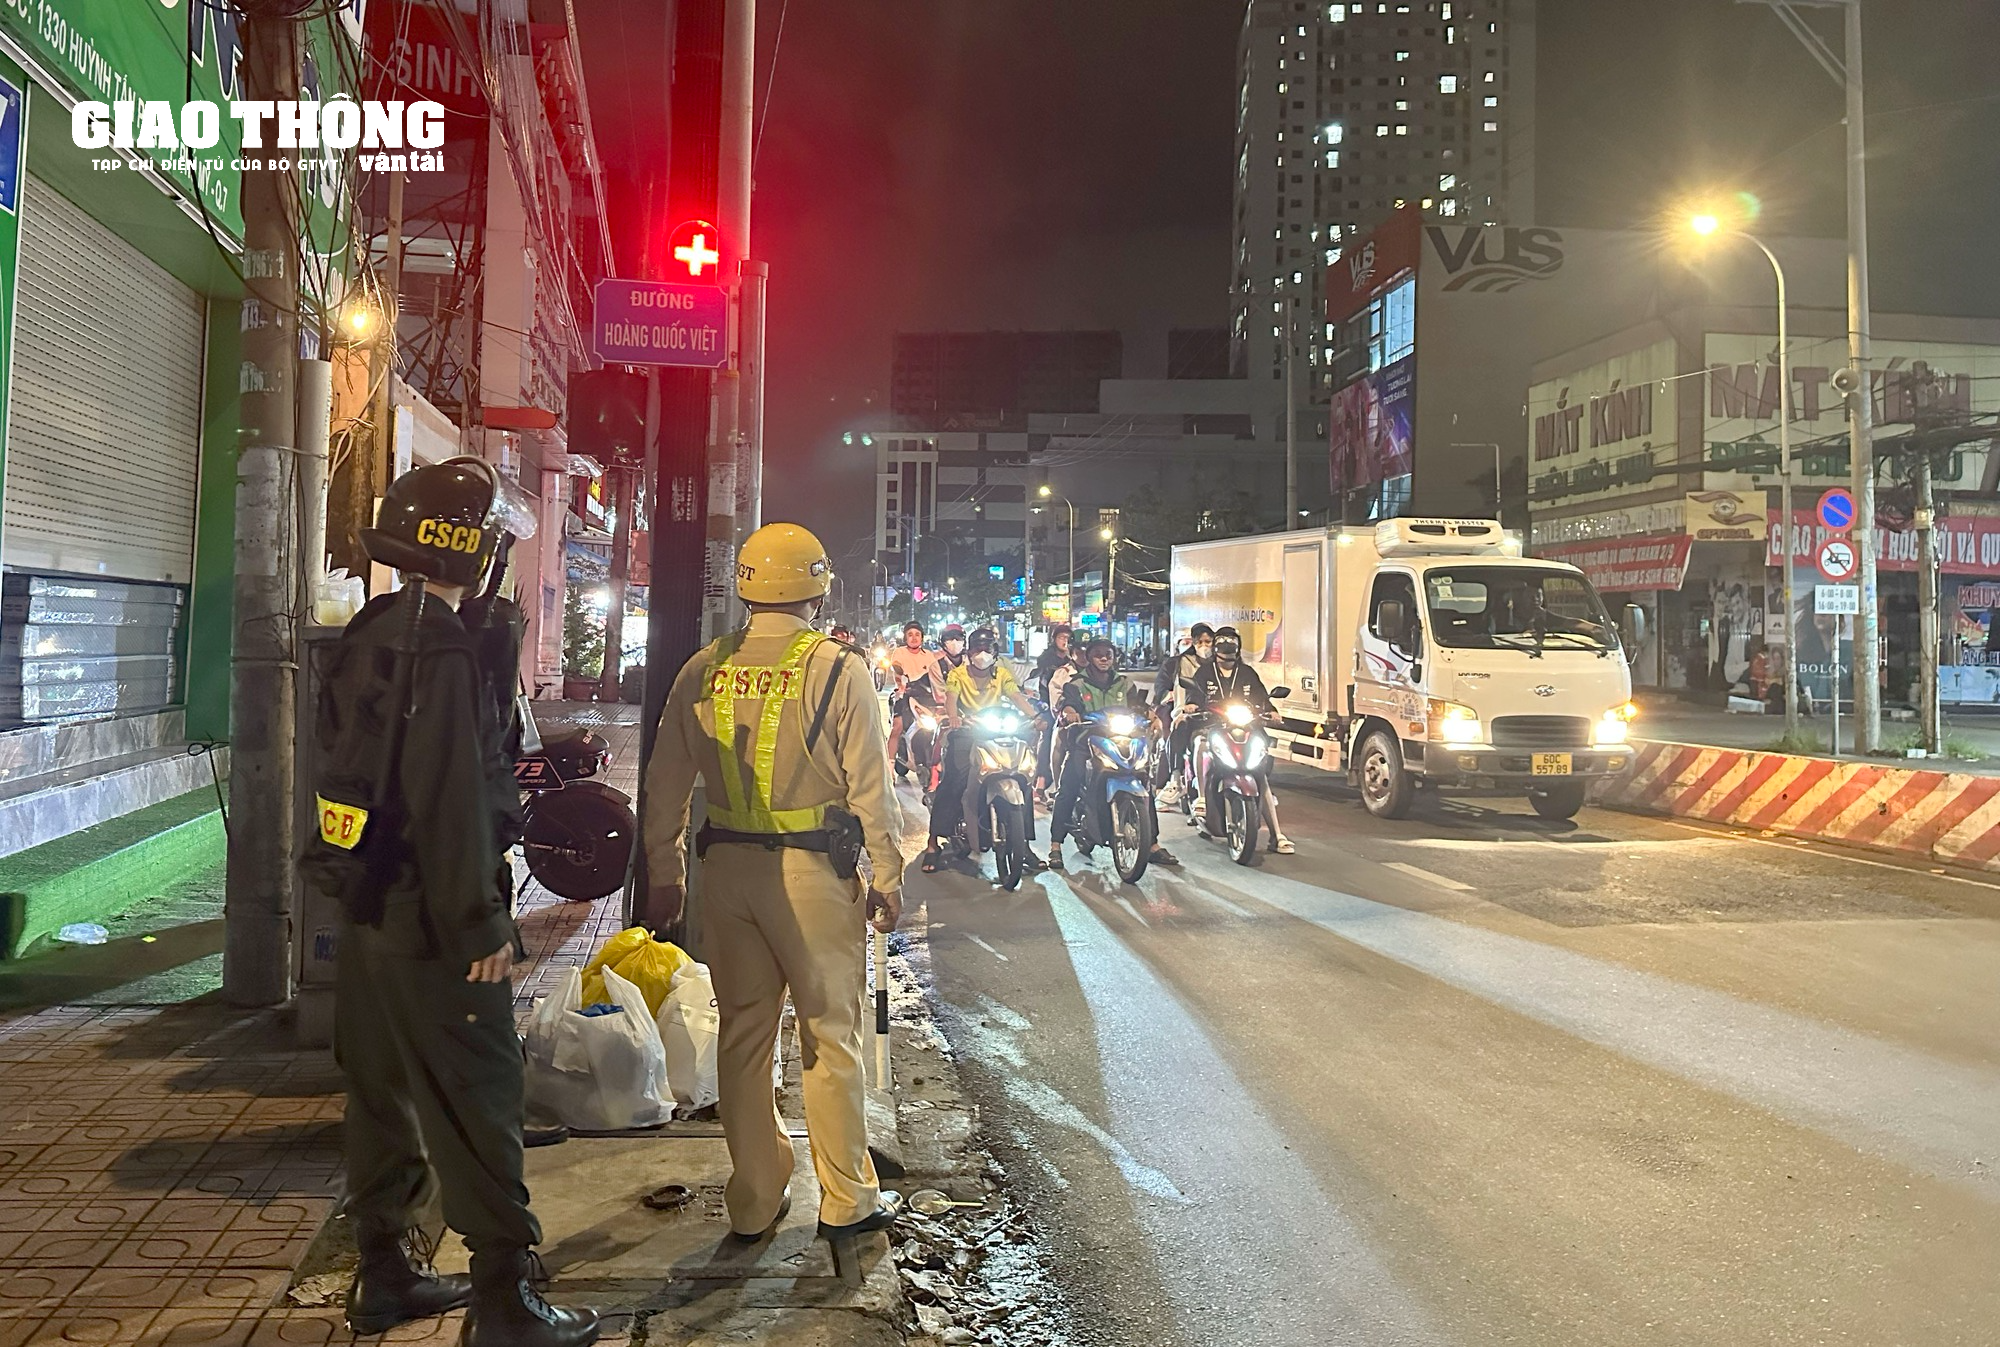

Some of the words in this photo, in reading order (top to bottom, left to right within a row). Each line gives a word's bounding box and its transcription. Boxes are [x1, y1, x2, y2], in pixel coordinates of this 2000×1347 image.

[37, 1, 67, 55] 1330
[69, 28, 113, 99] HUỲNH
[1424, 226, 1565, 281] VUS
[630, 288, 695, 310] ĐƯỜNG
[604, 318, 649, 348] HOÀNG
[652, 320, 687, 350] QUỐC
[690, 324, 718, 355] VIỆT
[1845, 356, 1971, 426] KÍH
[1535, 387, 1584, 462] MẮT
[1589, 378, 1653, 448] KÍNH
[1771, 515, 1812, 557] CÀO
[1888, 529, 1919, 569] HỌC
[1957, 522, 1976, 564] VÀ
[711, 669, 795, 695] CSGT
[513, 762, 544, 777] 73
[1536, 764, 1568, 774] 557.89
[1543, 755, 1561, 764] 60C
